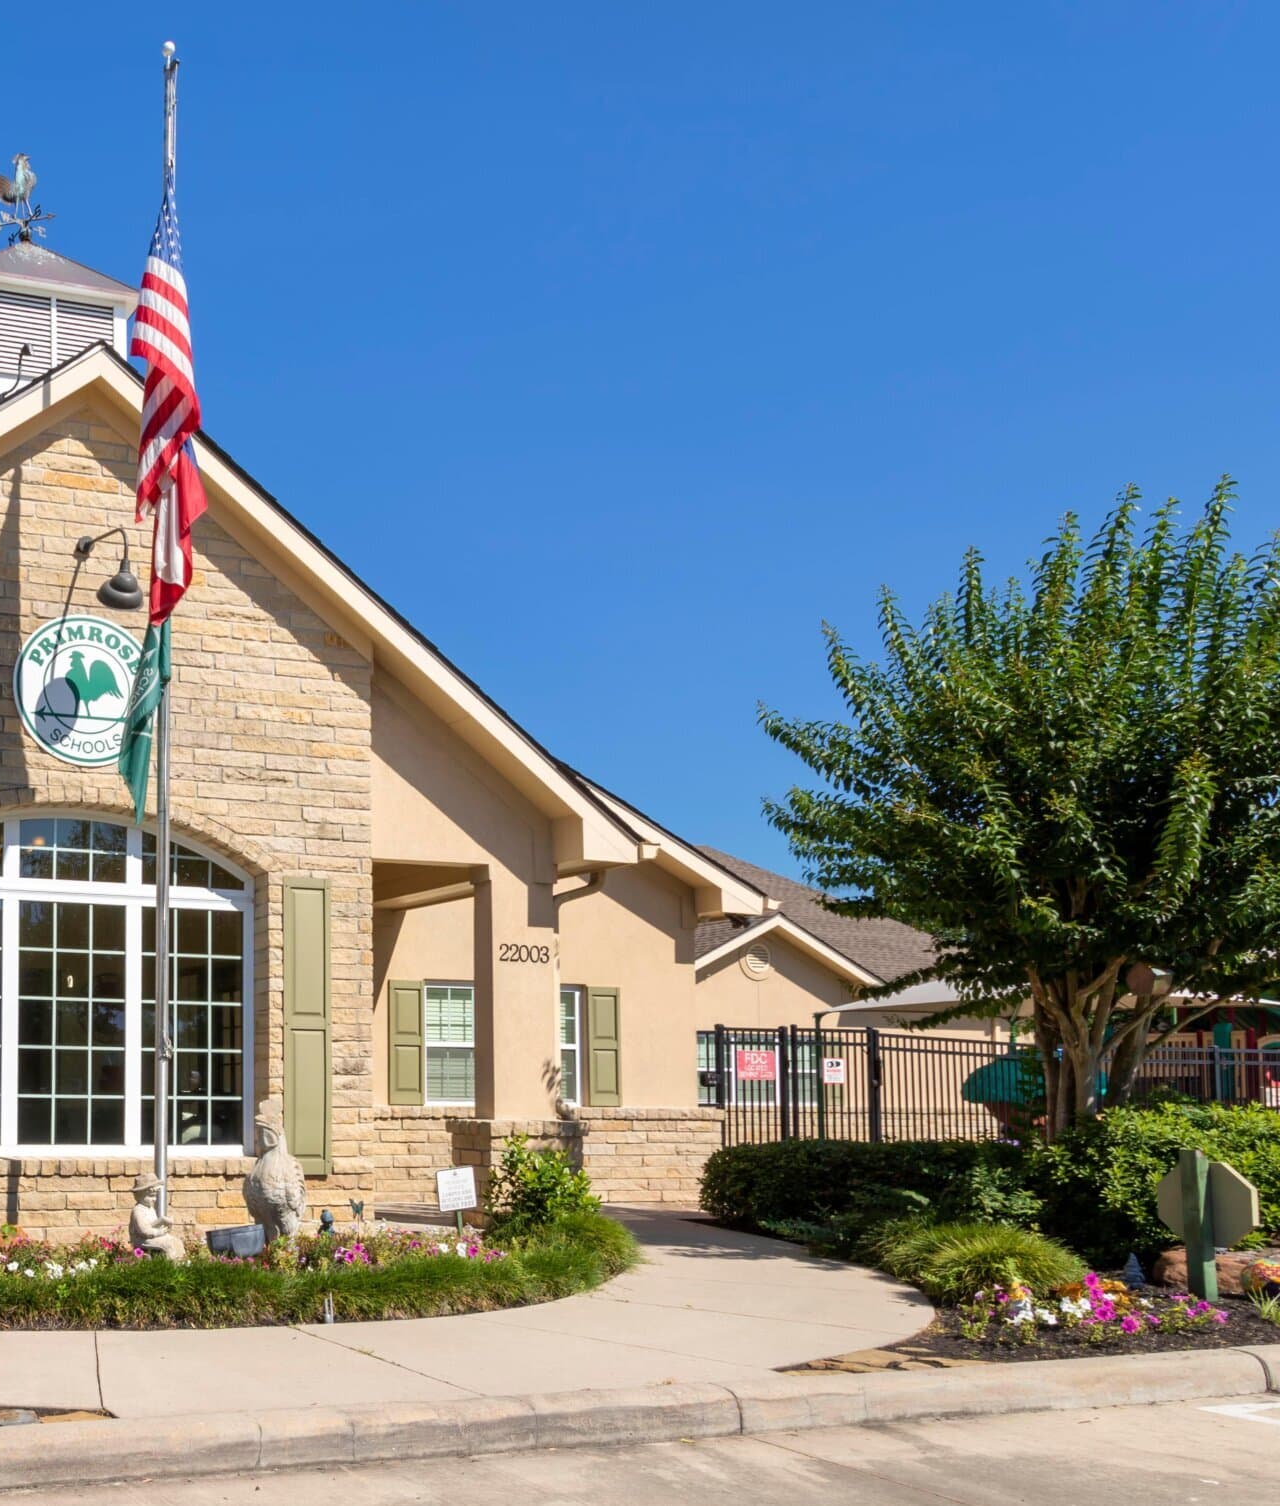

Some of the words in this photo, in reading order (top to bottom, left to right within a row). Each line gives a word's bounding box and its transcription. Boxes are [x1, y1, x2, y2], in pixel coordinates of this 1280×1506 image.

[50, 728, 122, 754] SCHOOLS
[499, 943, 550, 964] 22003
[745, 1053, 768, 1065] FDC
